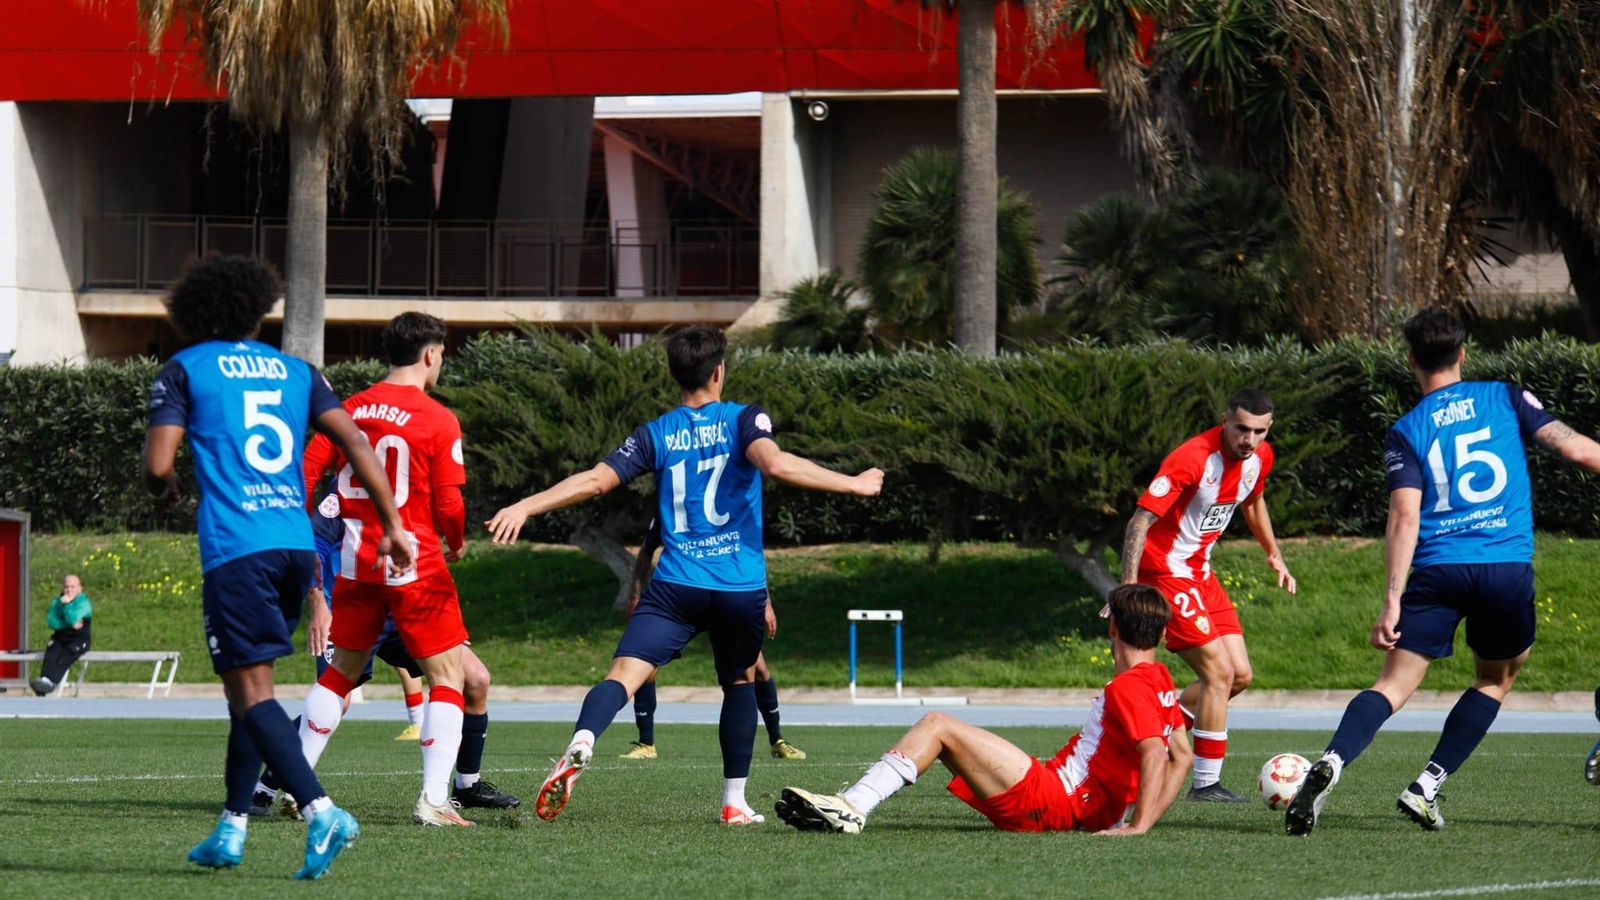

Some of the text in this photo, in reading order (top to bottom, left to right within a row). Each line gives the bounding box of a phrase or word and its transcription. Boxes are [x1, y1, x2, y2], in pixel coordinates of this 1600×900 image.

[218, 355, 288, 380] COLLAZO
[243, 389, 294, 474] 5
[352, 404, 412, 427] MARSU
[668, 452, 731, 534] 17
[1427, 425, 1508, 513] 15
[1174, 587, 1205, 618] 21
